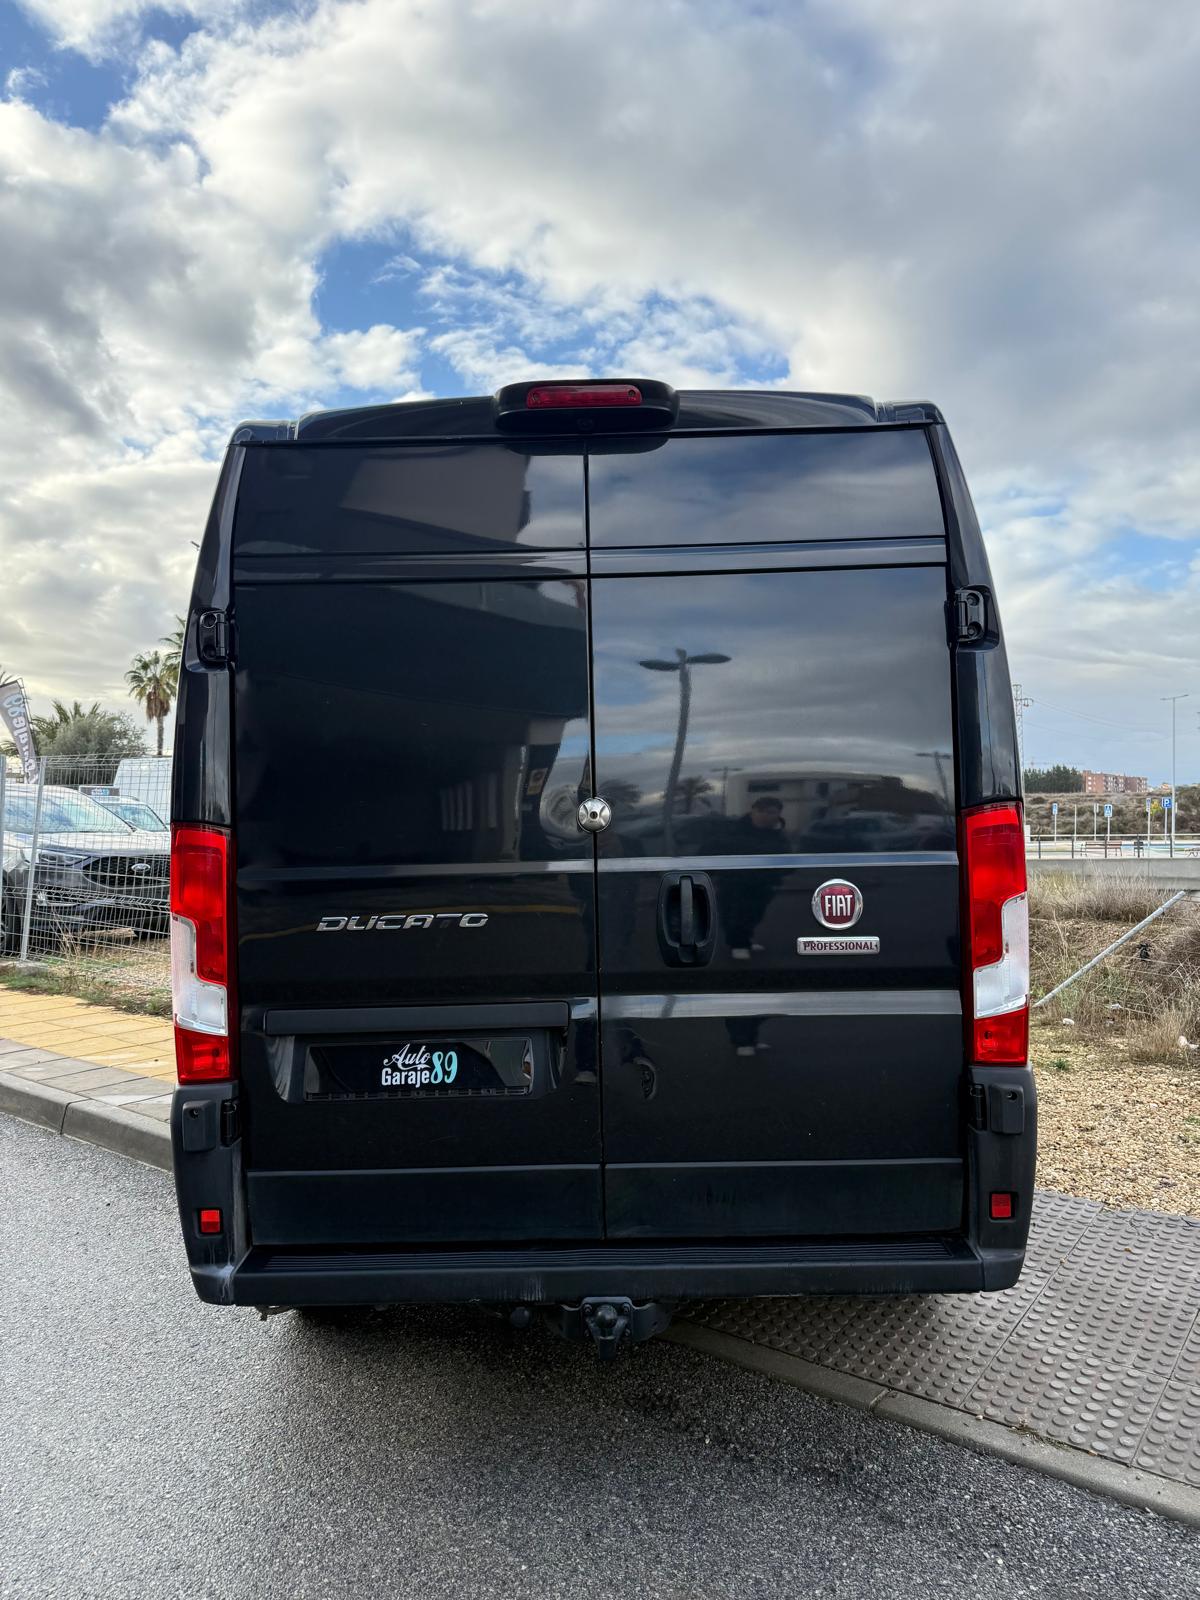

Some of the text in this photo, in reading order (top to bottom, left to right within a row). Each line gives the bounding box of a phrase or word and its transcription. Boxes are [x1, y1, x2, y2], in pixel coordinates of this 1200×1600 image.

[824, 894, 853, 917] FIAT
[316, 913, 489, 931] DUCATO
[803, 940, 874, 951] PROFESSIONAL
[383, 1043, 432, 1070] Auto
[381, 1051, 458, 1088] Garaje 89
